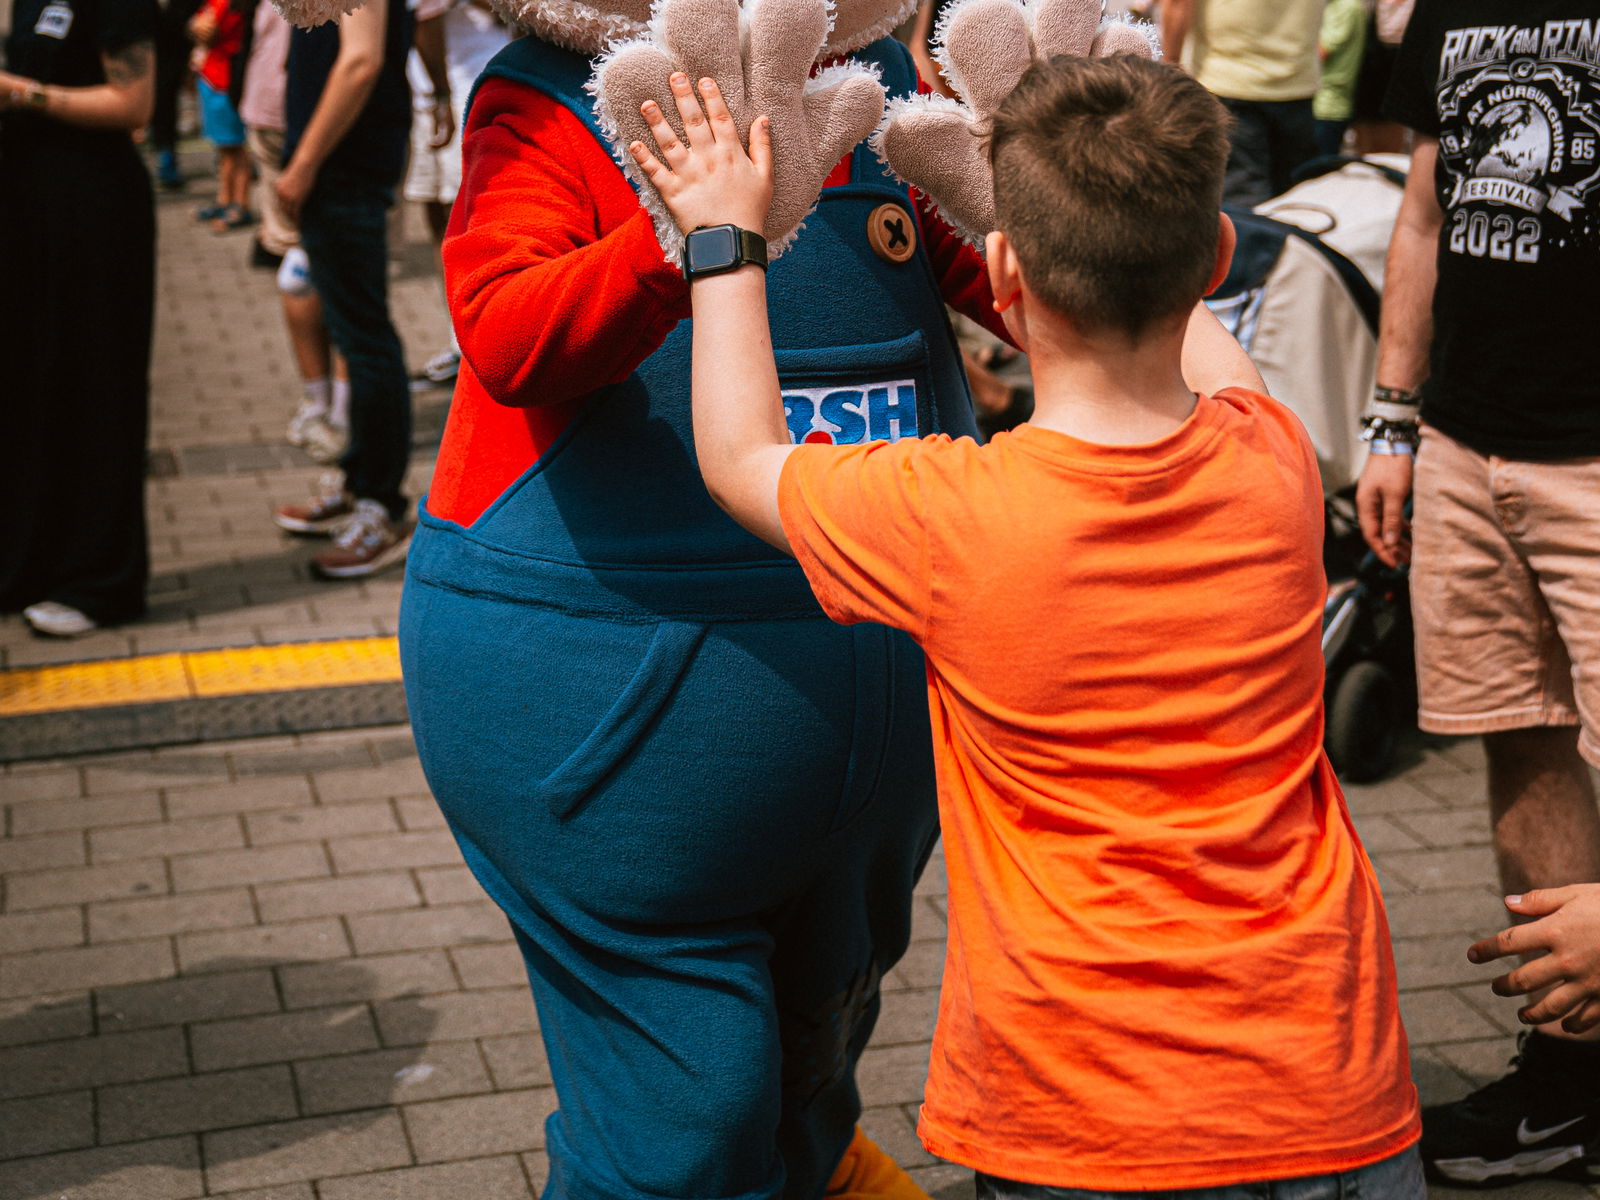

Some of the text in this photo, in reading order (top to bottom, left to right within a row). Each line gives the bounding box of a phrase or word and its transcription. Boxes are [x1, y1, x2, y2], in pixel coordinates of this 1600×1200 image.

[1440, 25, 1517, 84] ROCK
[1509, 27, 1541, 54] AM
[1467, 99, 1485, 126] AT
[1570, 138, 1596, 160] 85
[1464, 181, 1536, 208] FESTIVAL
[1450, 208, 1542, 264] 2022
